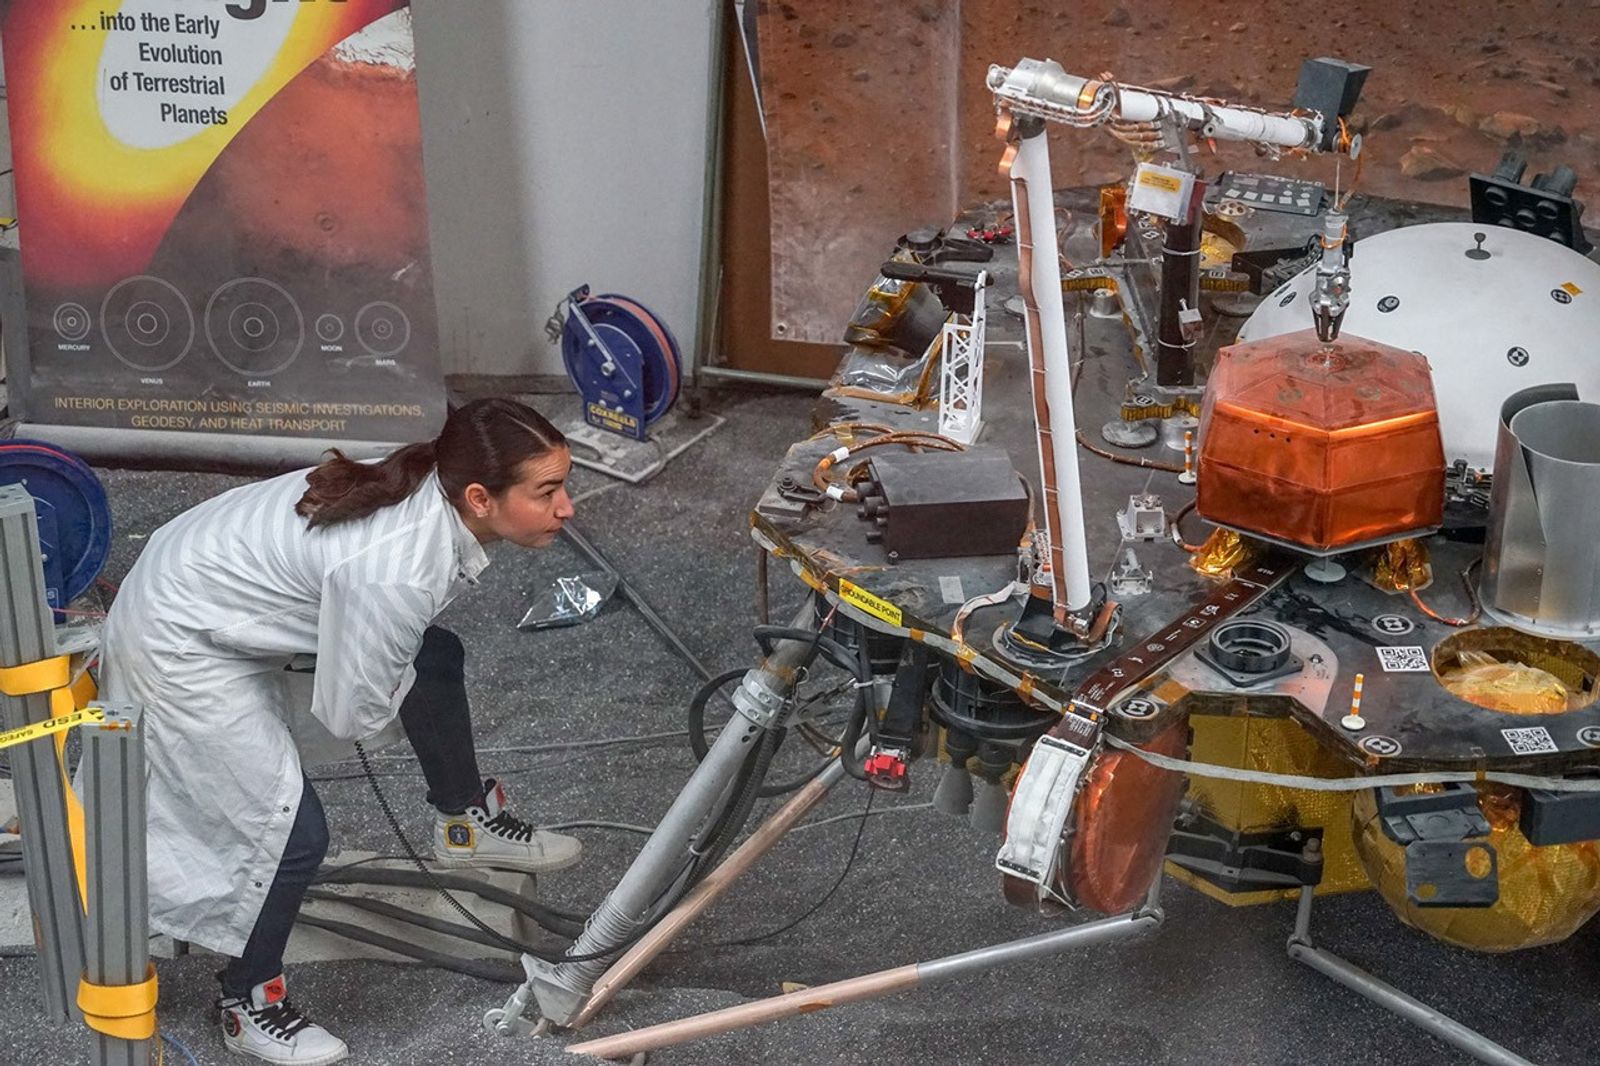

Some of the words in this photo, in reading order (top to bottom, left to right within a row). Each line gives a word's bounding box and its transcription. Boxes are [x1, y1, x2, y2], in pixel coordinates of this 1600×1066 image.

[140, 12, 170, 32] the
[175, 13, 220, 39] Early
[139, 42, 223, 65] Evolution
[110, 72, 128, 91] of
[133, 72, 225, 95] Terrestrial
[160, 103, 228, 125] Planets
[57, 343, 90, 351] MERCURY
[140, 377, 163, 385] VENUS
[54, 396, 115, 410] INTERIOR
[117, 398, 207, 413] EXPLORATION
[210, 400, 253, 414] USING
[255, 401, 310, 415] SEISMIC
[312, 402, 426, 417] INVESTIGATIONS,
[131, 415, 196, 428] GEODESY,
[199, 416, 228, 430] AND
[230, 417, 265, 430] HEAT
[267, 418, 347, 432] TRANSPORT
[43, 713, 82, 728] ESD
